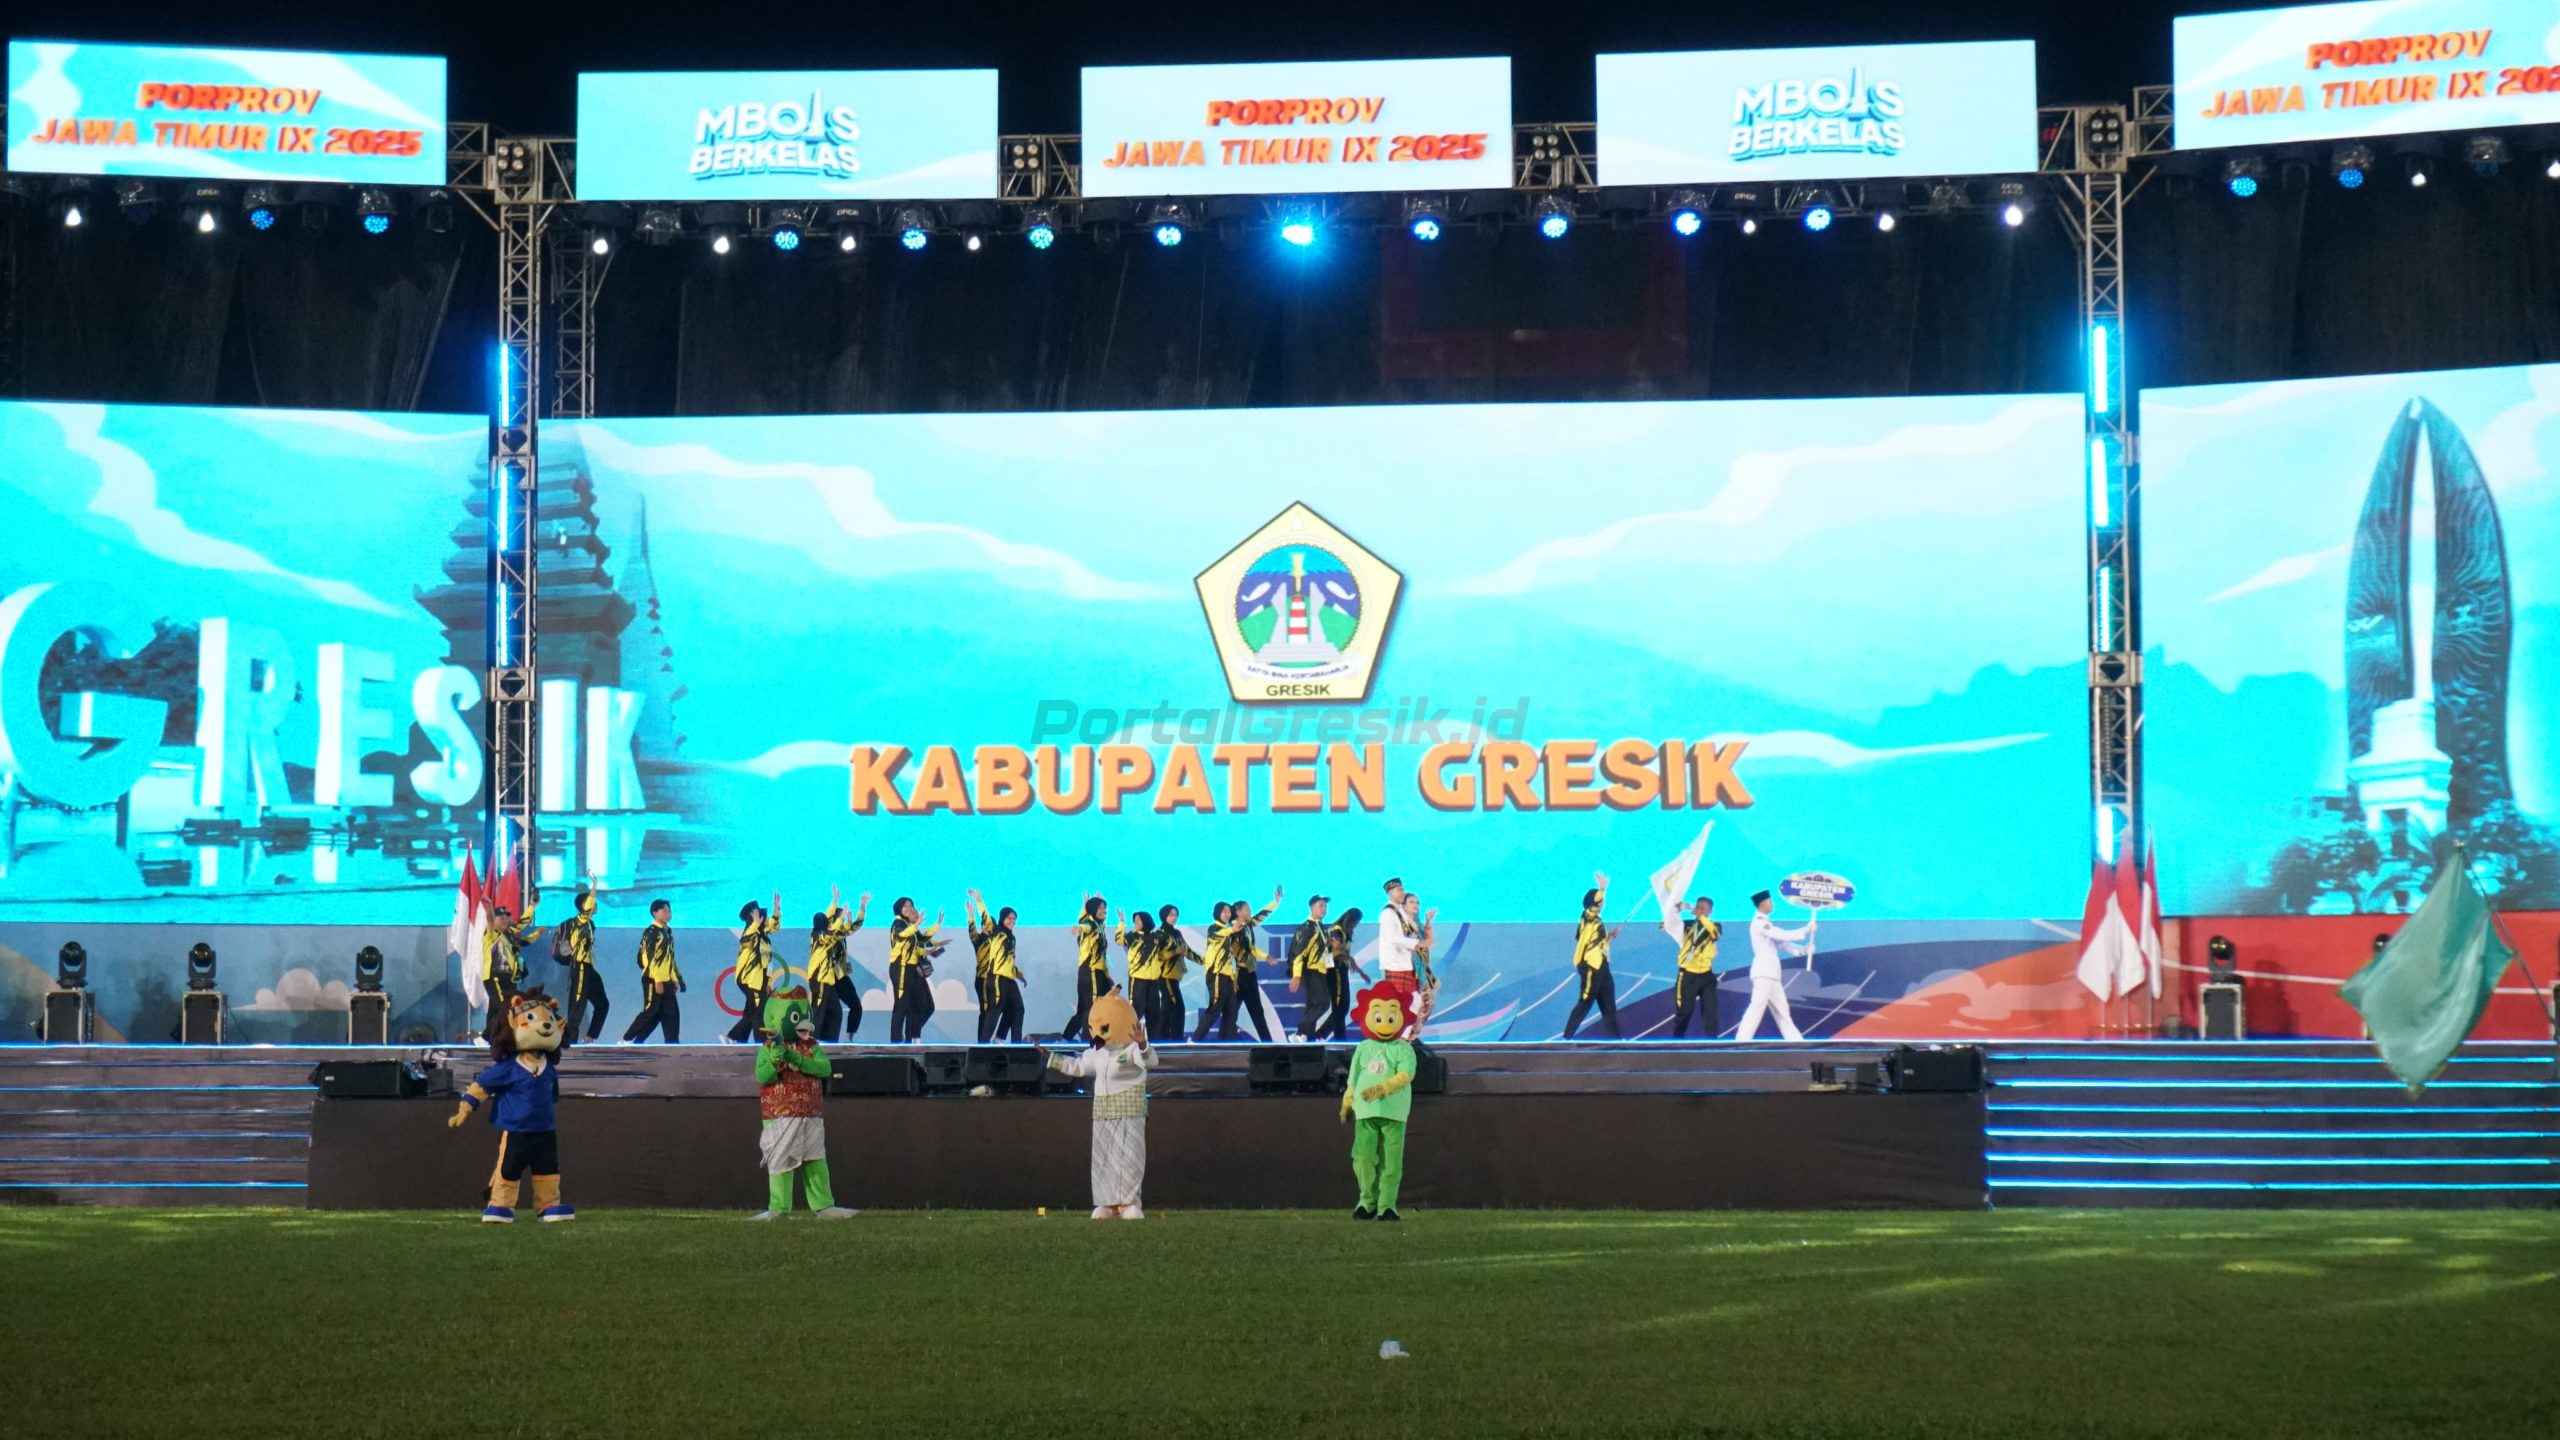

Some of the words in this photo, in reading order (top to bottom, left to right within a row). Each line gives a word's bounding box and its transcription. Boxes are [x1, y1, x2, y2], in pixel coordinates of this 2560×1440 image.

[2306, 29, 2492, 69] PORPROV
[138, 82, 320, 116] PORPROV
[1206, 97, 1385, 126] PORPROV
[2201, 85, 2305, 118] JAWA
[2321, 75, 2438, 109] TIMUR
[2447, 71, 2490, 99] IX
[32, 117, 137, 146] JAWA
[153, 121, 266, 151] TIMUR
[277, 126, 317, 153] IX
[324, 128, 423, 157] 2025
[1103, 141, 1205, 168] JAWA
[1220, 138, 1333, 165] TIMUR
[1342, 135, 1382, 163] IX
[1388, 133, 1488, 162] 2025
[1728, 119, 1904, 161] BERKELAS
[689, 141, 860, 180] BERKELAS
[0, 579, 646, 810] GRESIK
[1266, 684, 1331, 697] GRESIK
[849, 742, 1386, 815] KABUPATEN
[1417, 737, 1754, 811] GRESIK
